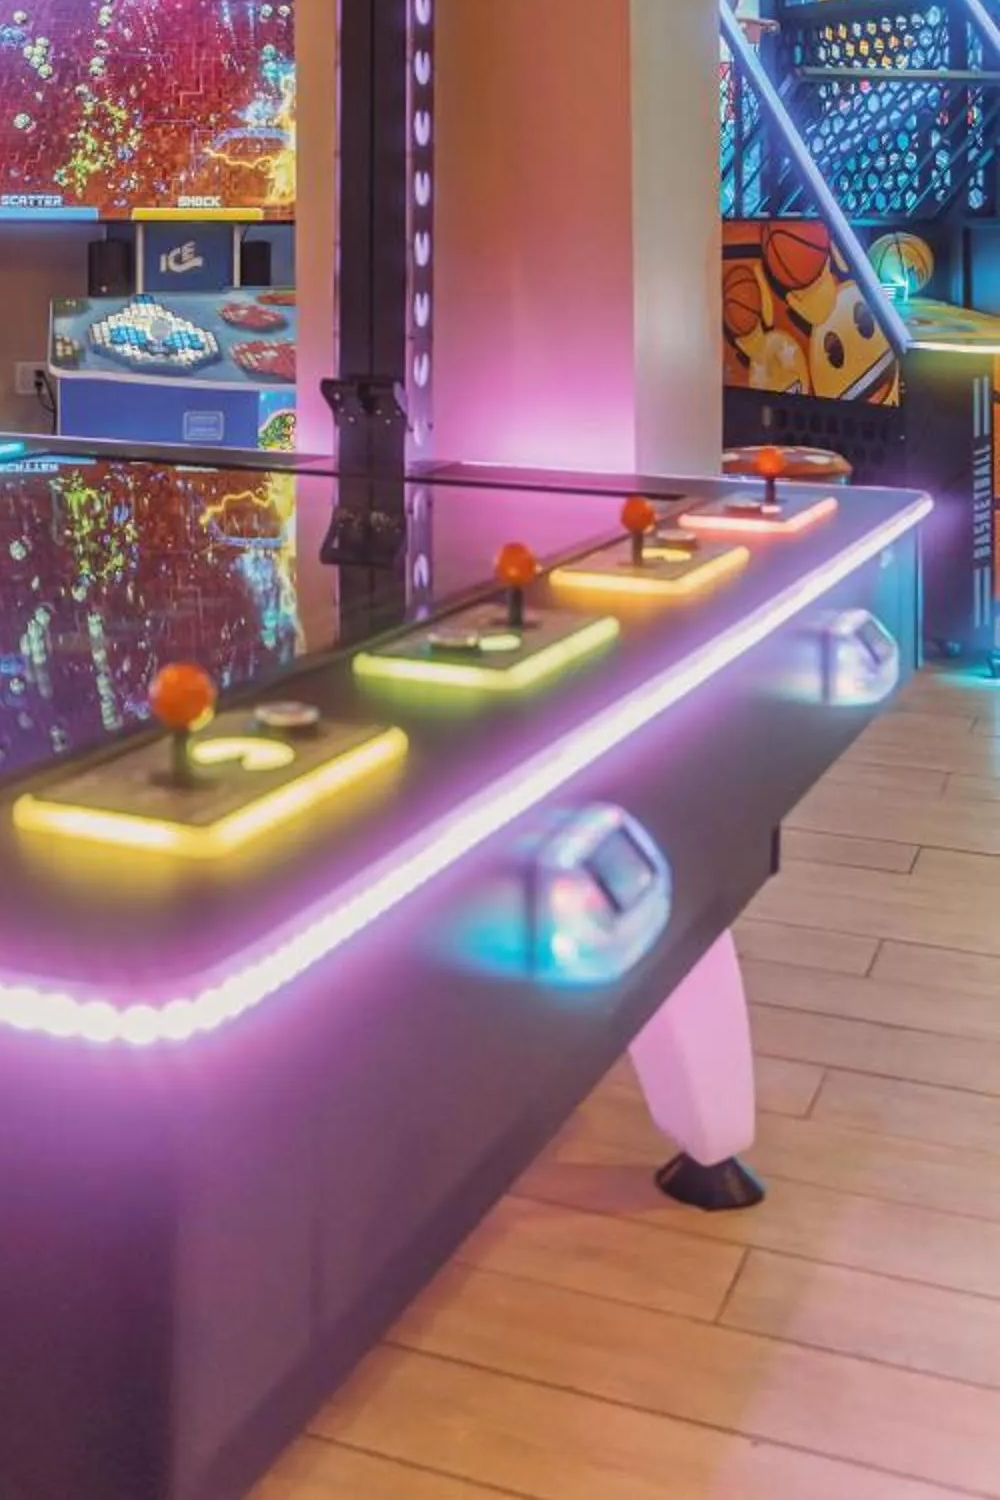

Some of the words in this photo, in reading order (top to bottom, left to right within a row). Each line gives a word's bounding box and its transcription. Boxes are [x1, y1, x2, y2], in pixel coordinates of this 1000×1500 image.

[0, 194, 63, 207] SCATTER
[159, 240, 203, 274] ICE
[972, 444, 991, 559] BASKETBALL
